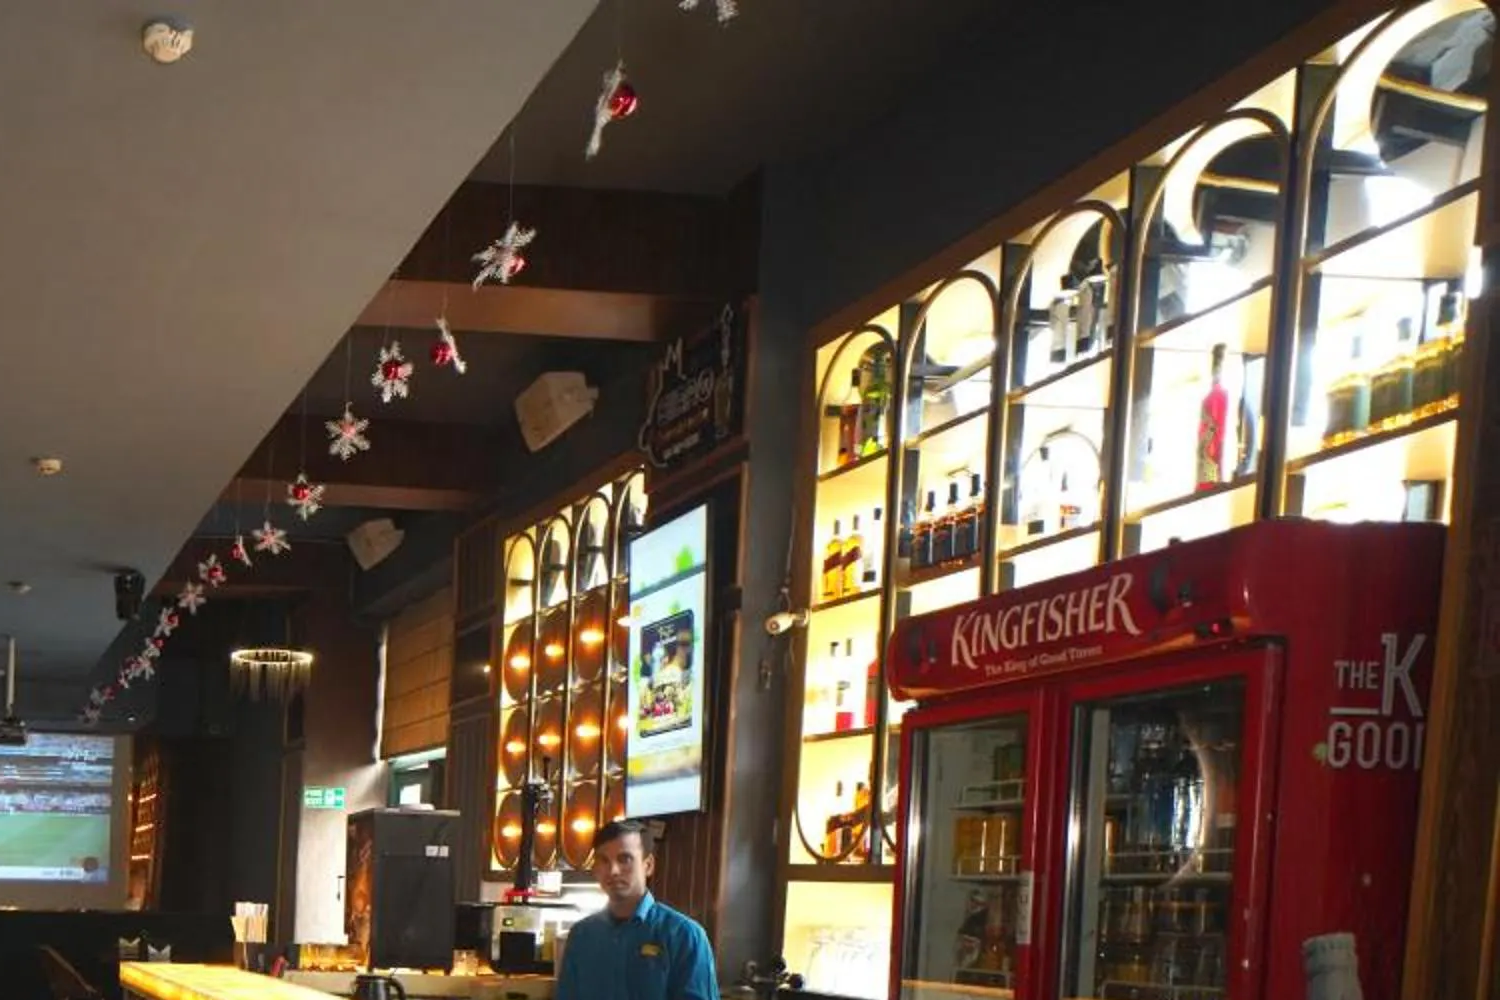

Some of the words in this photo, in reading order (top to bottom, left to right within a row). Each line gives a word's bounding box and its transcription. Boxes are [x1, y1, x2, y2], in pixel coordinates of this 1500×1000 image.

[951, 573, 1143, 669] KINGFISHER
[1334, 660, 1380, 689] THE
[1381, 633, 1426, 717] K
[1328, 721, 1424, 771] GOO
